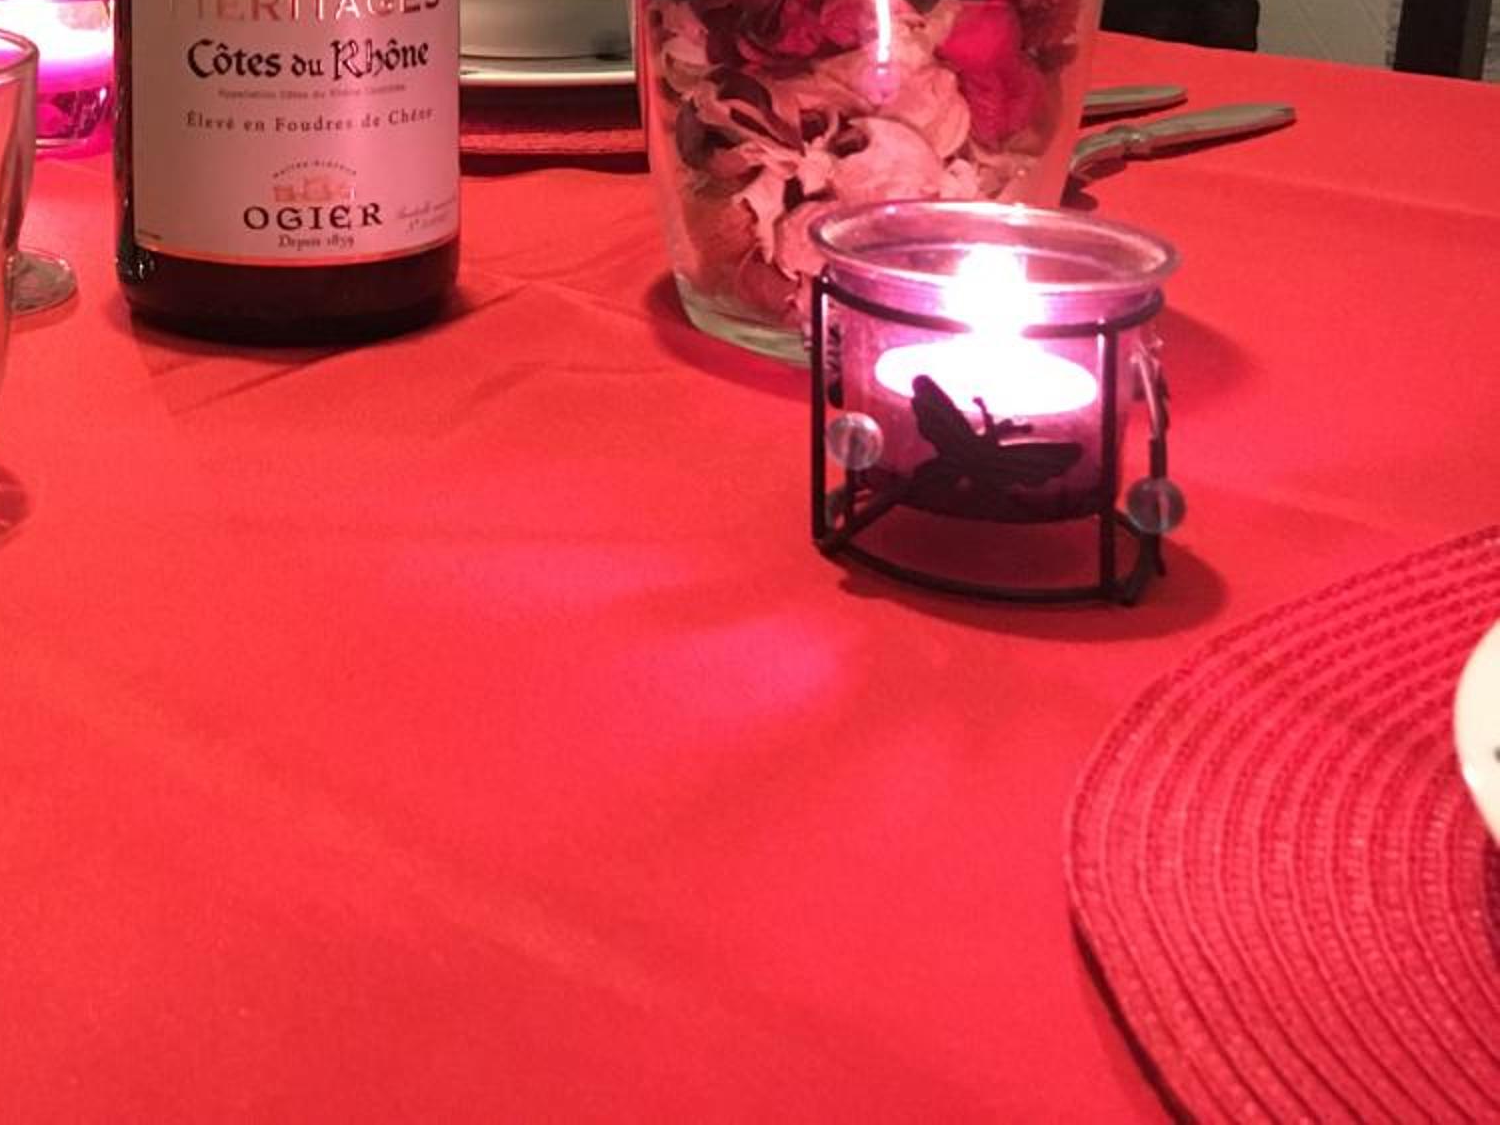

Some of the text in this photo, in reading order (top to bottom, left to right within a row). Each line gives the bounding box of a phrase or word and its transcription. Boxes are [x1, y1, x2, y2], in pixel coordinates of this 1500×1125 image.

[187, 38, 430, 81] Côtes du Rhône
[187, 106, 433, 133] Élevé en Foudres de Chêne
[243, 202, 383, 231] OGIER
[277, 234, 322, 251] Depuis
